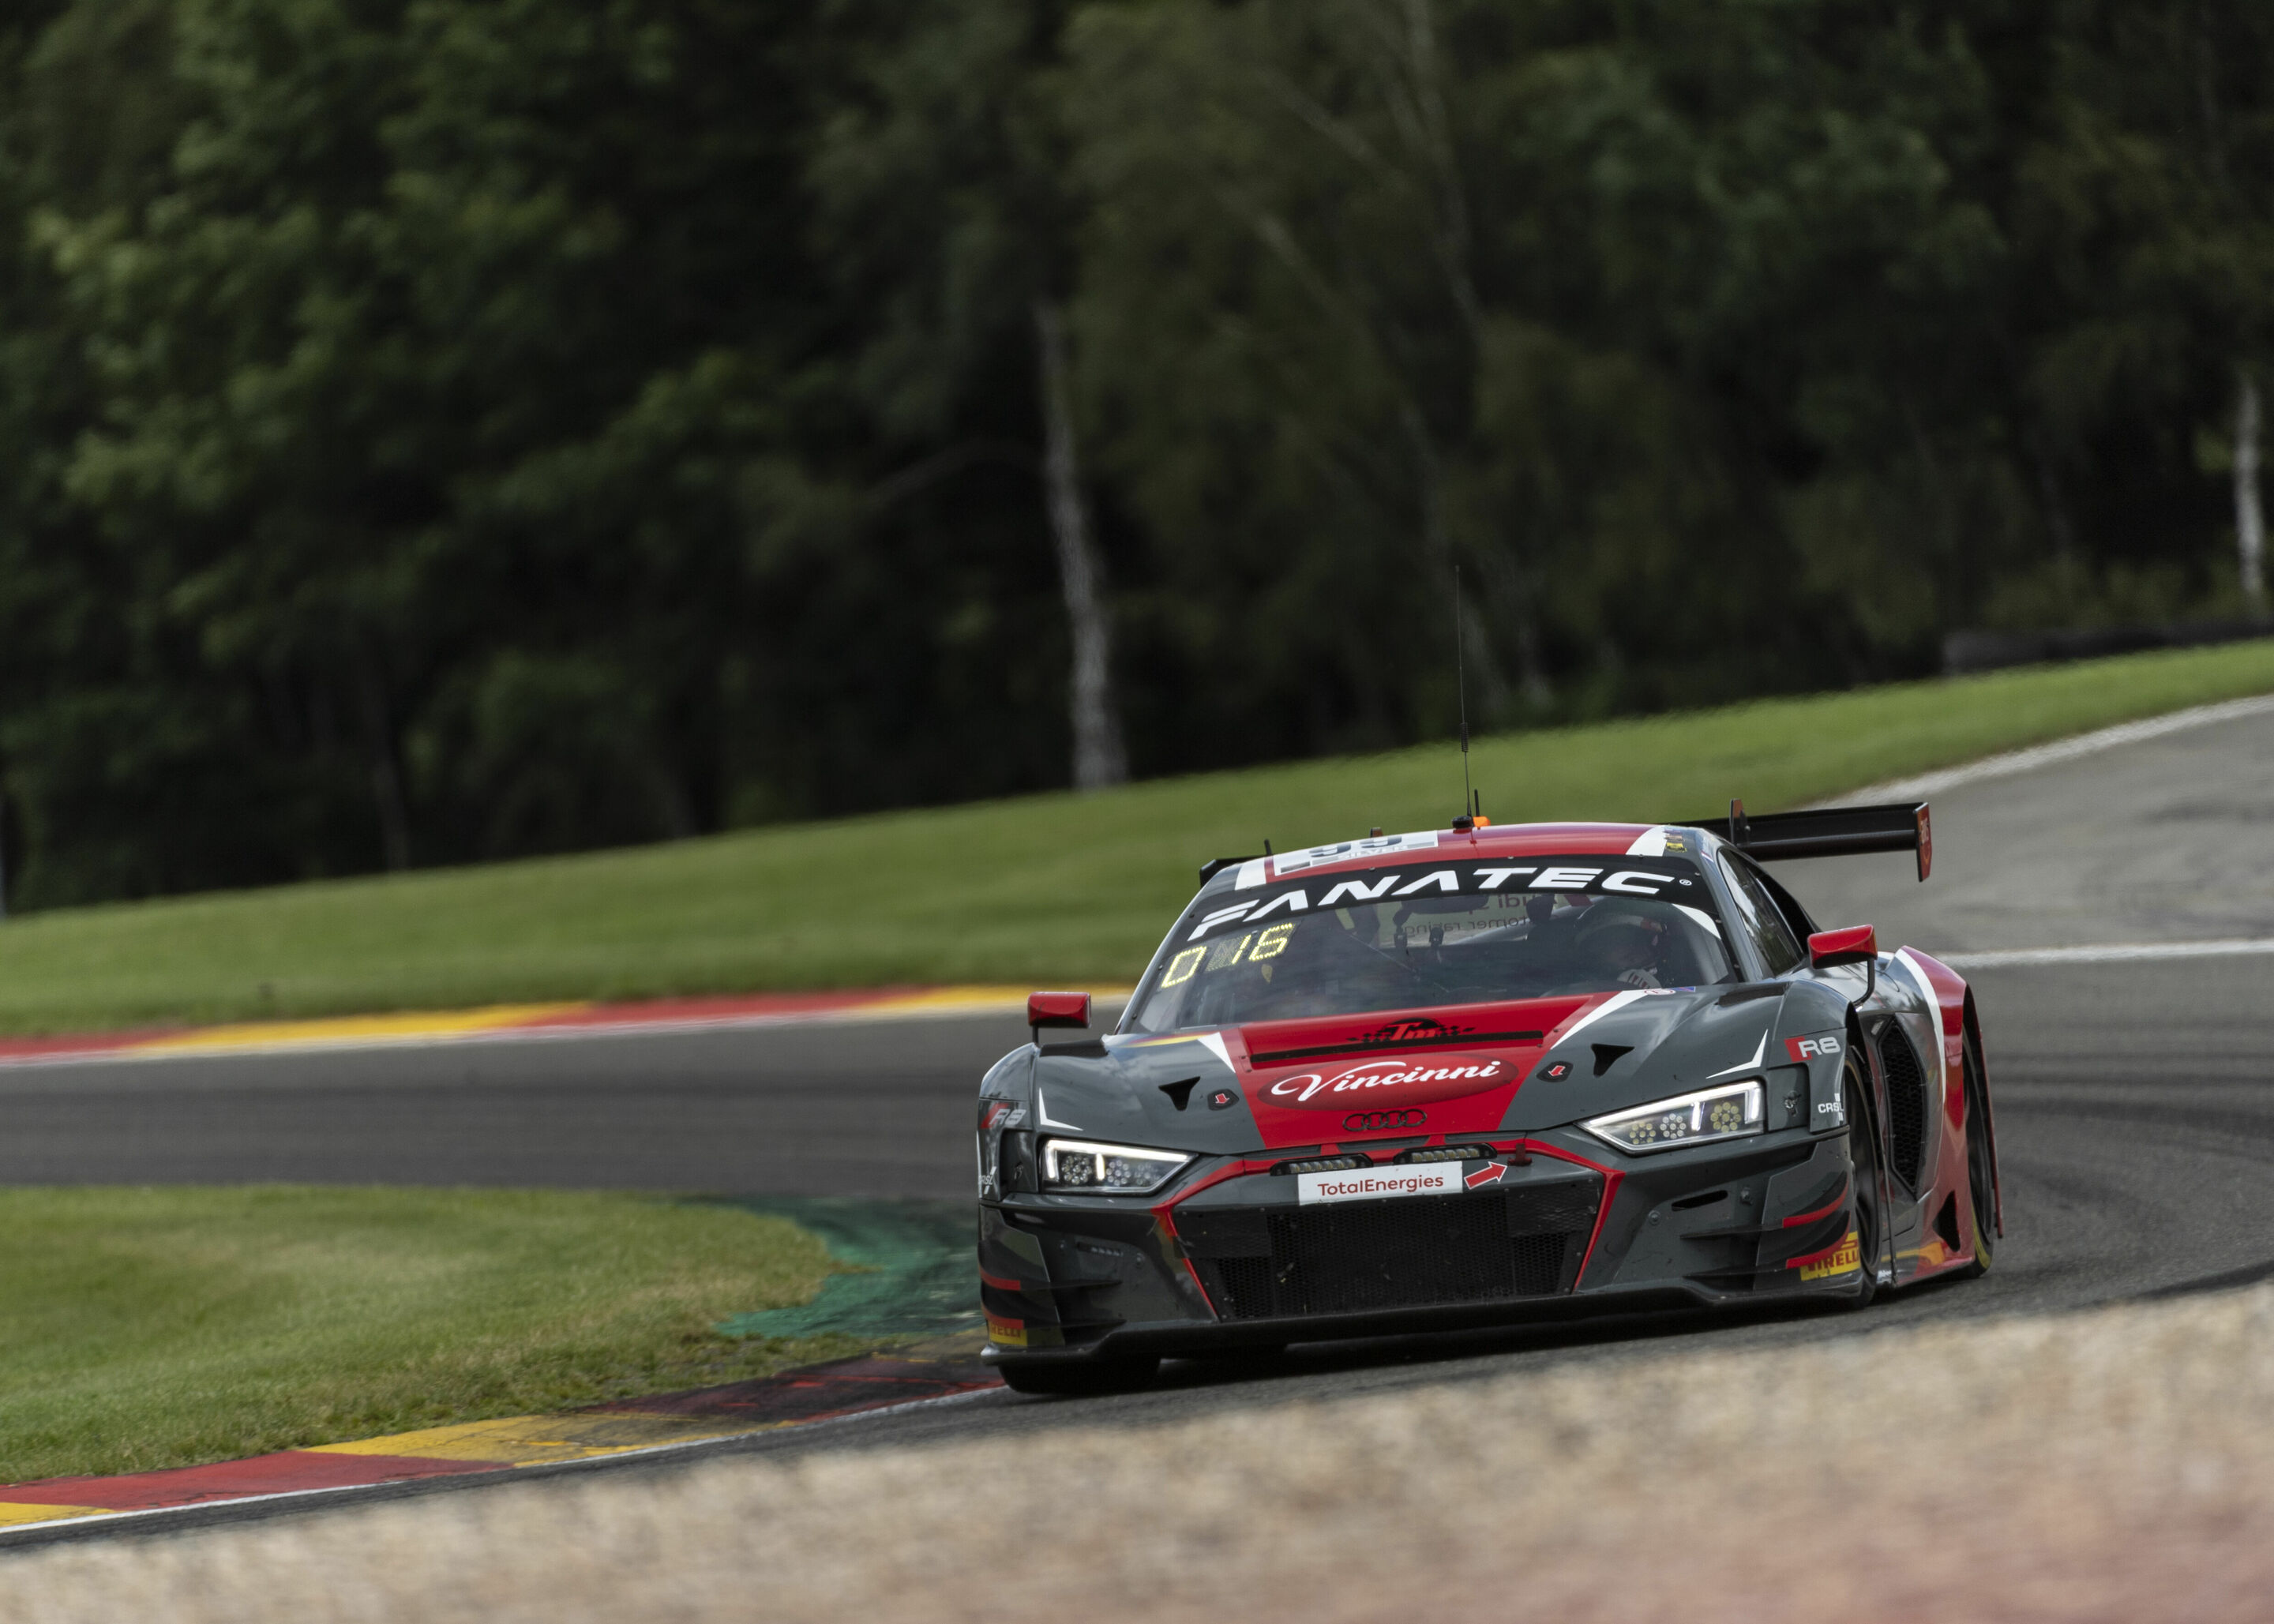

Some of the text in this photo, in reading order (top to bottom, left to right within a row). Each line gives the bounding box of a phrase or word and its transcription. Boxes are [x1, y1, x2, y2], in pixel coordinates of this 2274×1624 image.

[1187, 867, 1675, 941] FANATEC
[1798, 1037, 1841, 1058] R8
[1270, 1060, 1501, 1101] Vincinni
[989, 1108, 1027, 1126] R8
[1317, 1174, 1444, 1197] TotalEnergies
